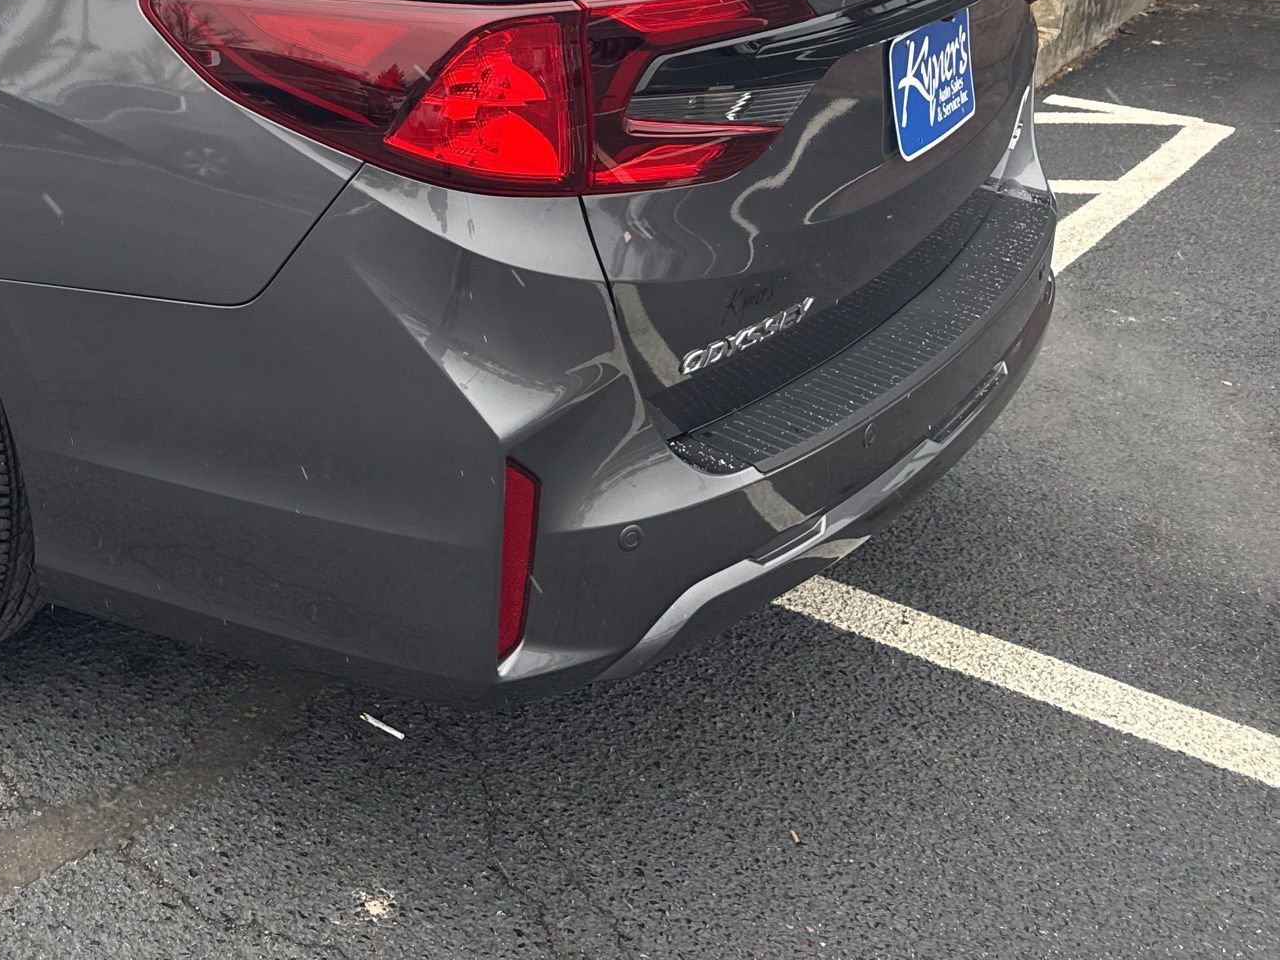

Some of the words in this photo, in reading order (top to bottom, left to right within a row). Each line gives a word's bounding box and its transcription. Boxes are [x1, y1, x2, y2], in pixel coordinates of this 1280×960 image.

[898, 25, 968, 128] Kyner's
[937, 106, 943, 122] &
[680, 296, 815, 375] ODYSSEY
